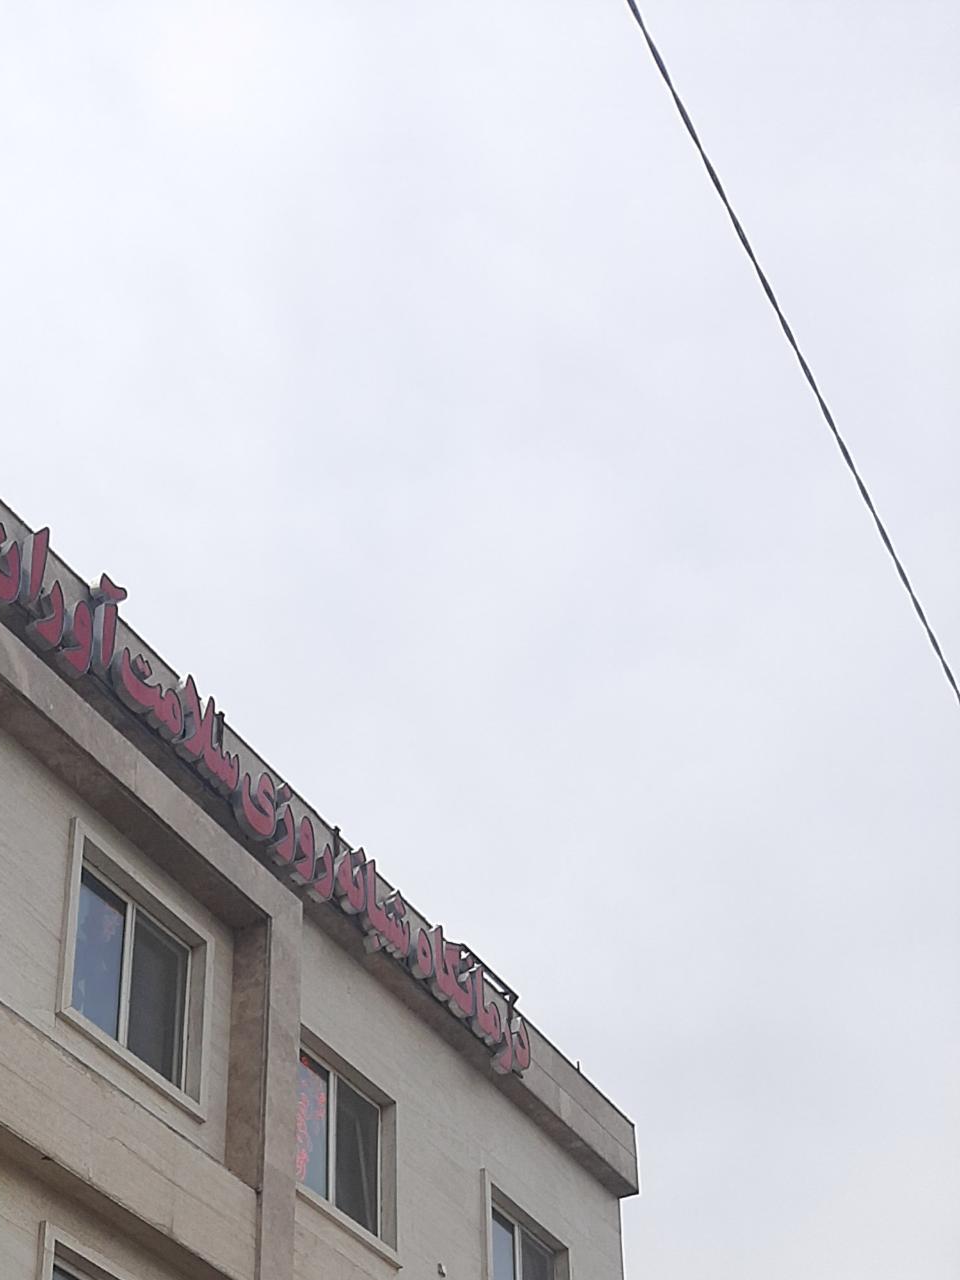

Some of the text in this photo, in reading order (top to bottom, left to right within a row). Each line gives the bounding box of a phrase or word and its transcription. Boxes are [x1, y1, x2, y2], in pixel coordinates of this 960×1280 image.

[117, 646, 240, 795] سلامت
[337, 847, 411, 958] شبانه
[415, 922, 531, 1074] درمانگاه
